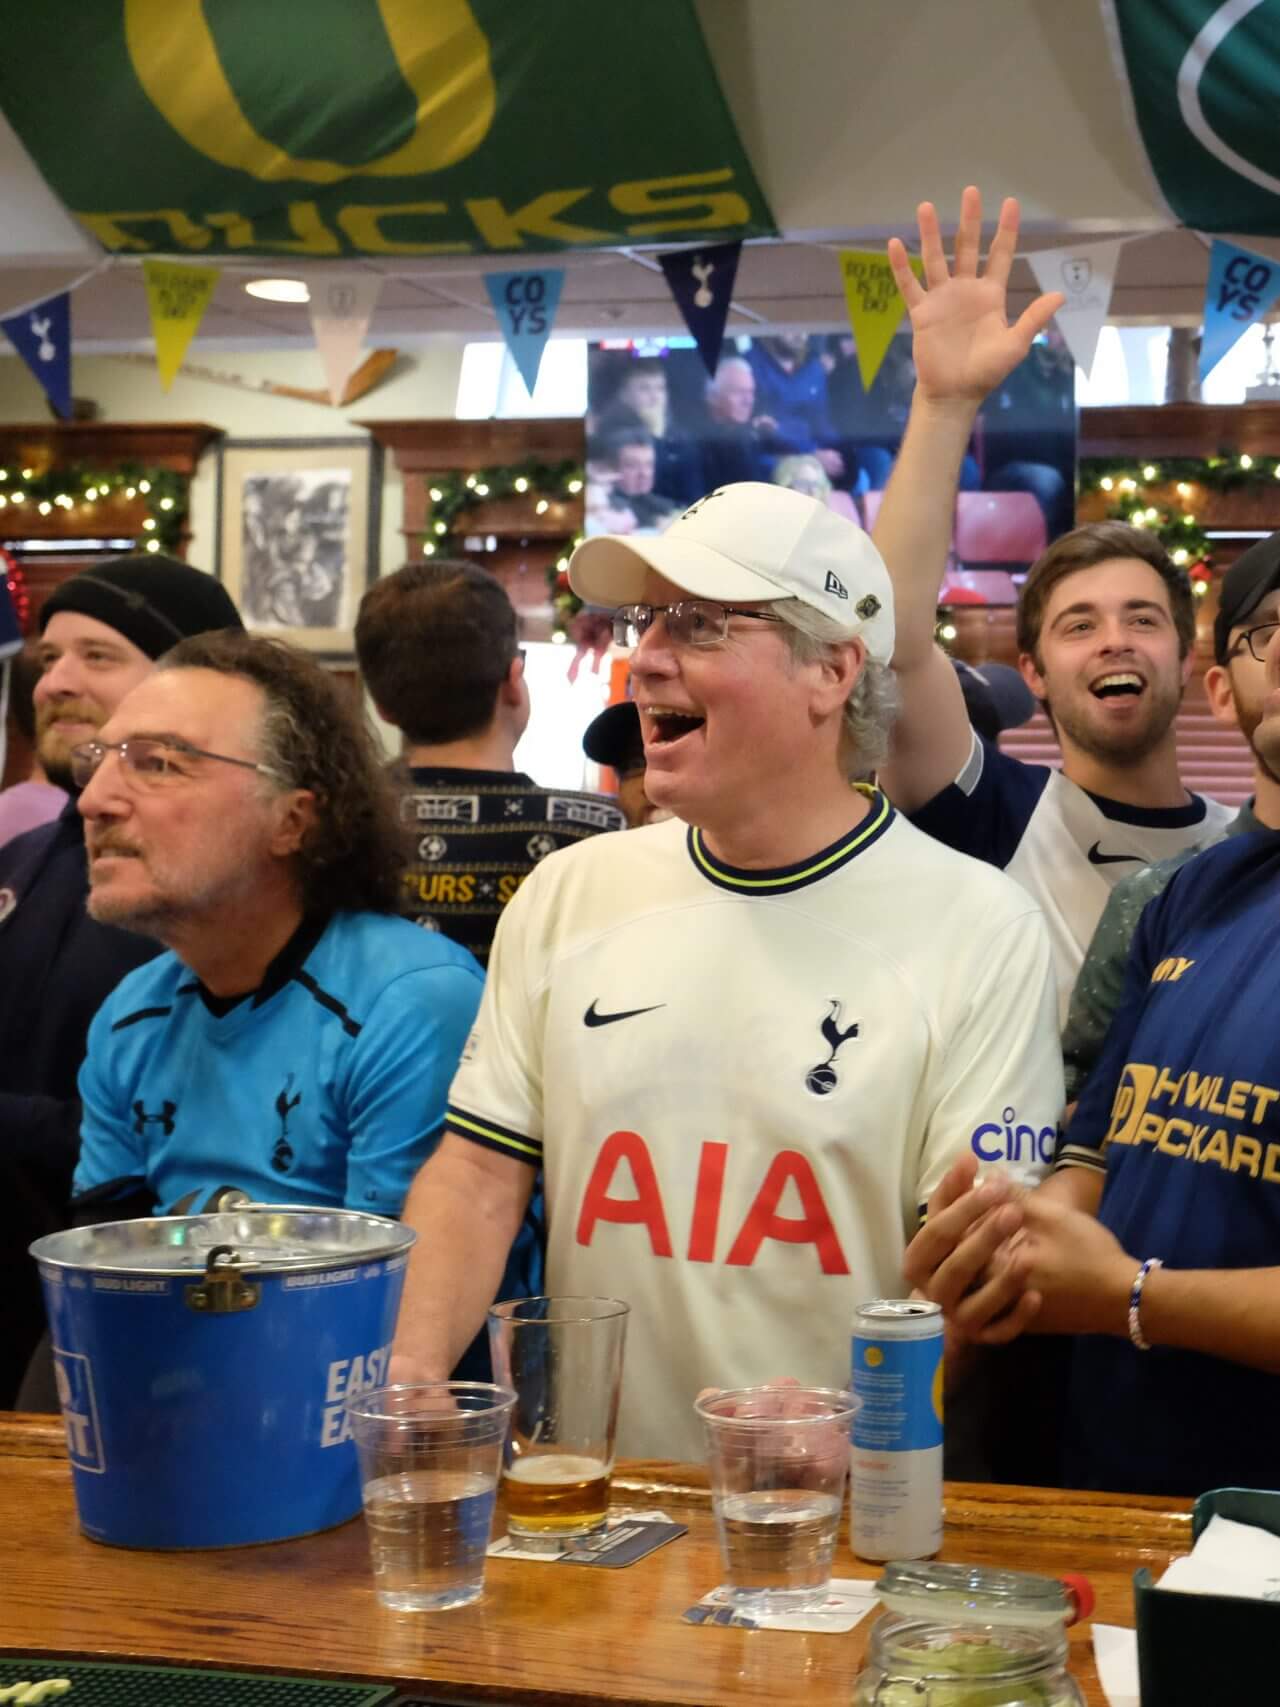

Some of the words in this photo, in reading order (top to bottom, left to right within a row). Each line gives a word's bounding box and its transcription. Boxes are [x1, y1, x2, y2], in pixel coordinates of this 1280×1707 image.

[505, 274, 546, 304] CO
[1225, 256, 1272, 292] CO
[508, 305, 548, 336] YS
[1216, 283, 1260, 321] YS
[970, 1106, 1060, 1164] cinc
[575, 1130, 852, 1276] AIA
